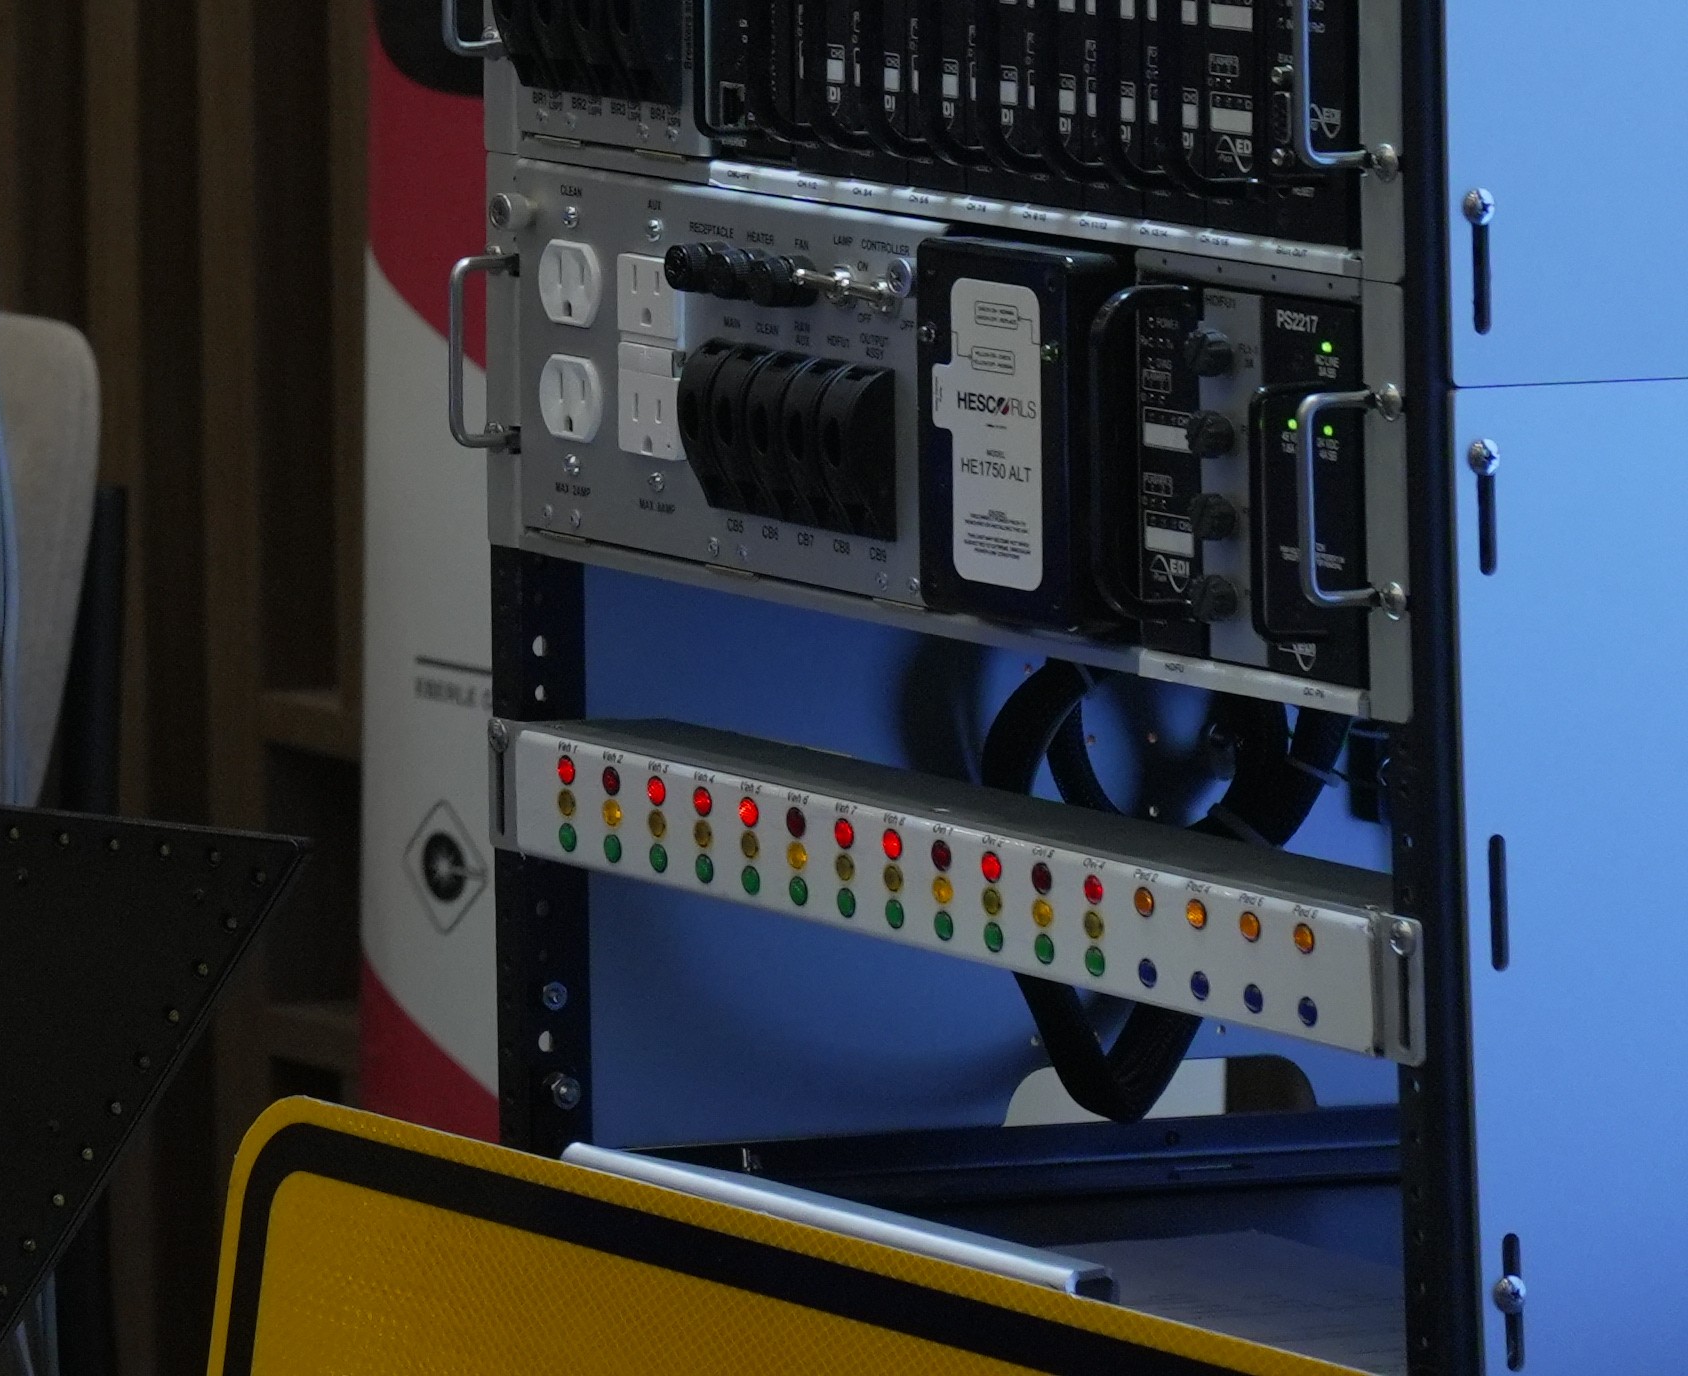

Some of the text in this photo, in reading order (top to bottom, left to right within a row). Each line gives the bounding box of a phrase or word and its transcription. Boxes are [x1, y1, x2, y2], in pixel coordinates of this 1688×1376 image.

[560, 184, 583, 198] CLEAN
[647, 199, 662, 211] AUX
[690, 221, 734, 239] RECEPTACLE
[747, 231, 774, 245] HEATER
[794, 238, 809, 250] FAN
[834, 235, 853, 247] LAMP
[861, 238, 910, 257] CONTROLLER
[857, 261, 868, 272] ON
[858, 313, 872, 324] OFF
[1276, 309, 1319, 333] PS2217
[756, 322, 779, 336] CLEAN
[900, 320, 914, 331] OFF
[986, 449, 1006, 459] MODEL
[961, 457, 1032, 483] HE1750 ALT
[727, 518, 744, 533] CB5
[797, 532, 814, 548] CB7
[869, 546, 887, 563] CB9
[1170, 559, 1190, 577] EDI
[557, 741, 571, 752] Veh
[602, 751, 616, 763] Veh
[648, 761, 662, 772] Veh
[694, 771, 708, 783] Veh
[740, 781, 754, 793] Veh
[787, 791, 802, 803] Veh
[835, 802, 850, 814] Veh
[884, 812, 898, 824] Veh
[1133, 868, 1149, 881] Ped
[1186, 881, 1202, 893] Ped
[1239, 893, 1255, 905] Ped
[1292, 904, 1309, 918] Ped
